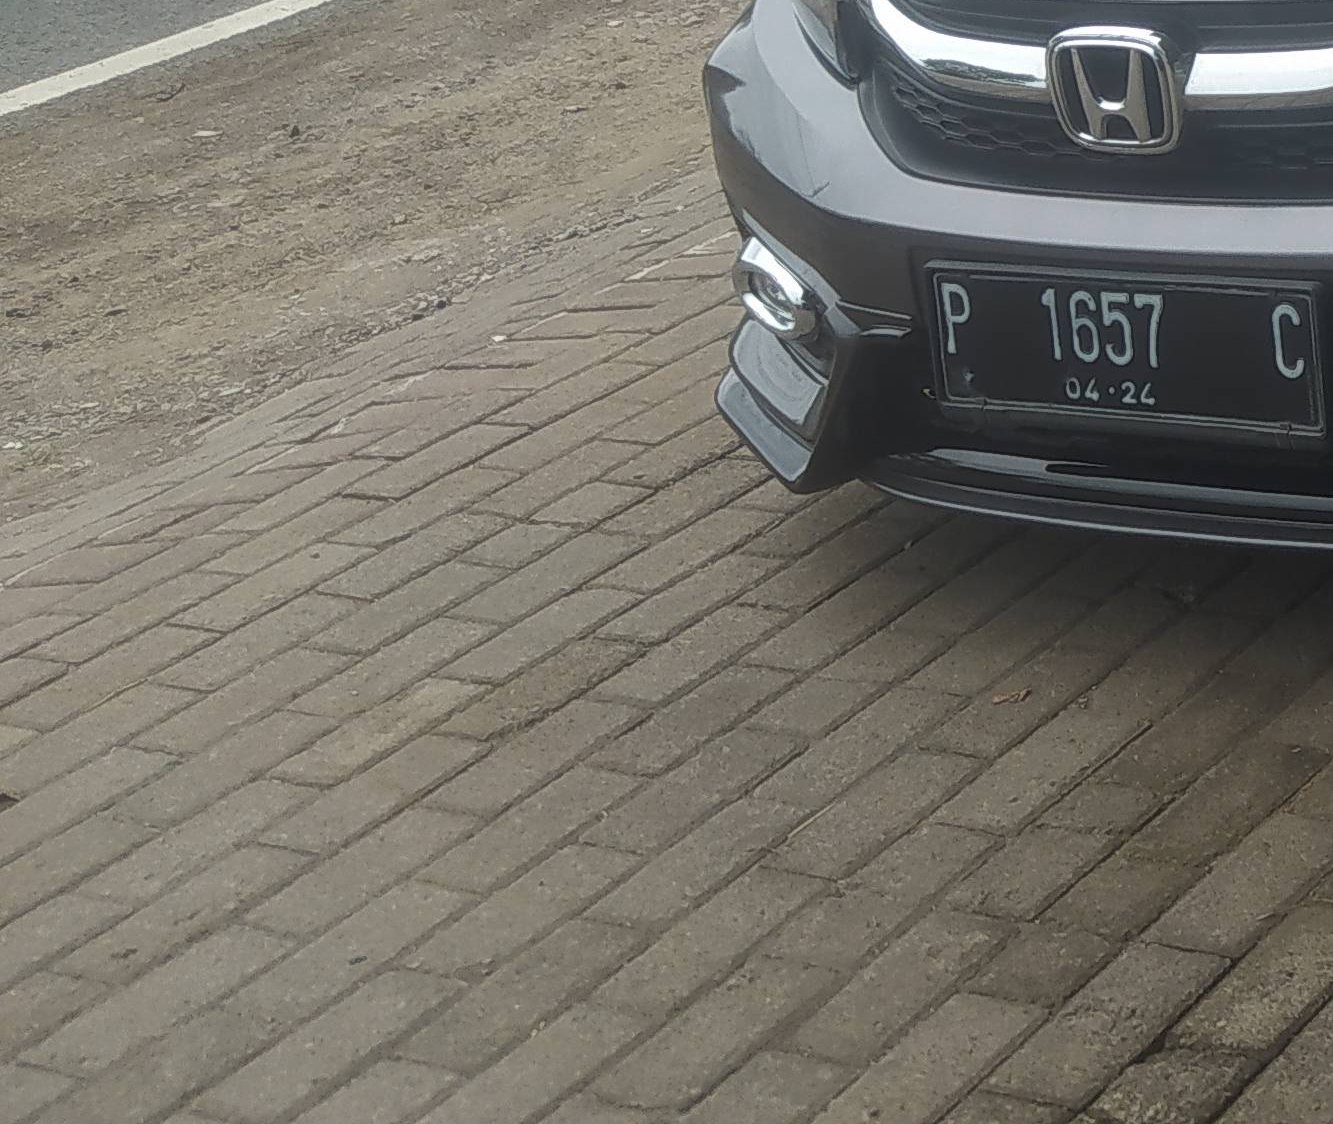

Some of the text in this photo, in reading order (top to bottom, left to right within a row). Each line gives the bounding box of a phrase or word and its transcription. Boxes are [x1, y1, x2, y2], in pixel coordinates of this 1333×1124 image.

[940, 282, 1306, 380] P 1657 C
